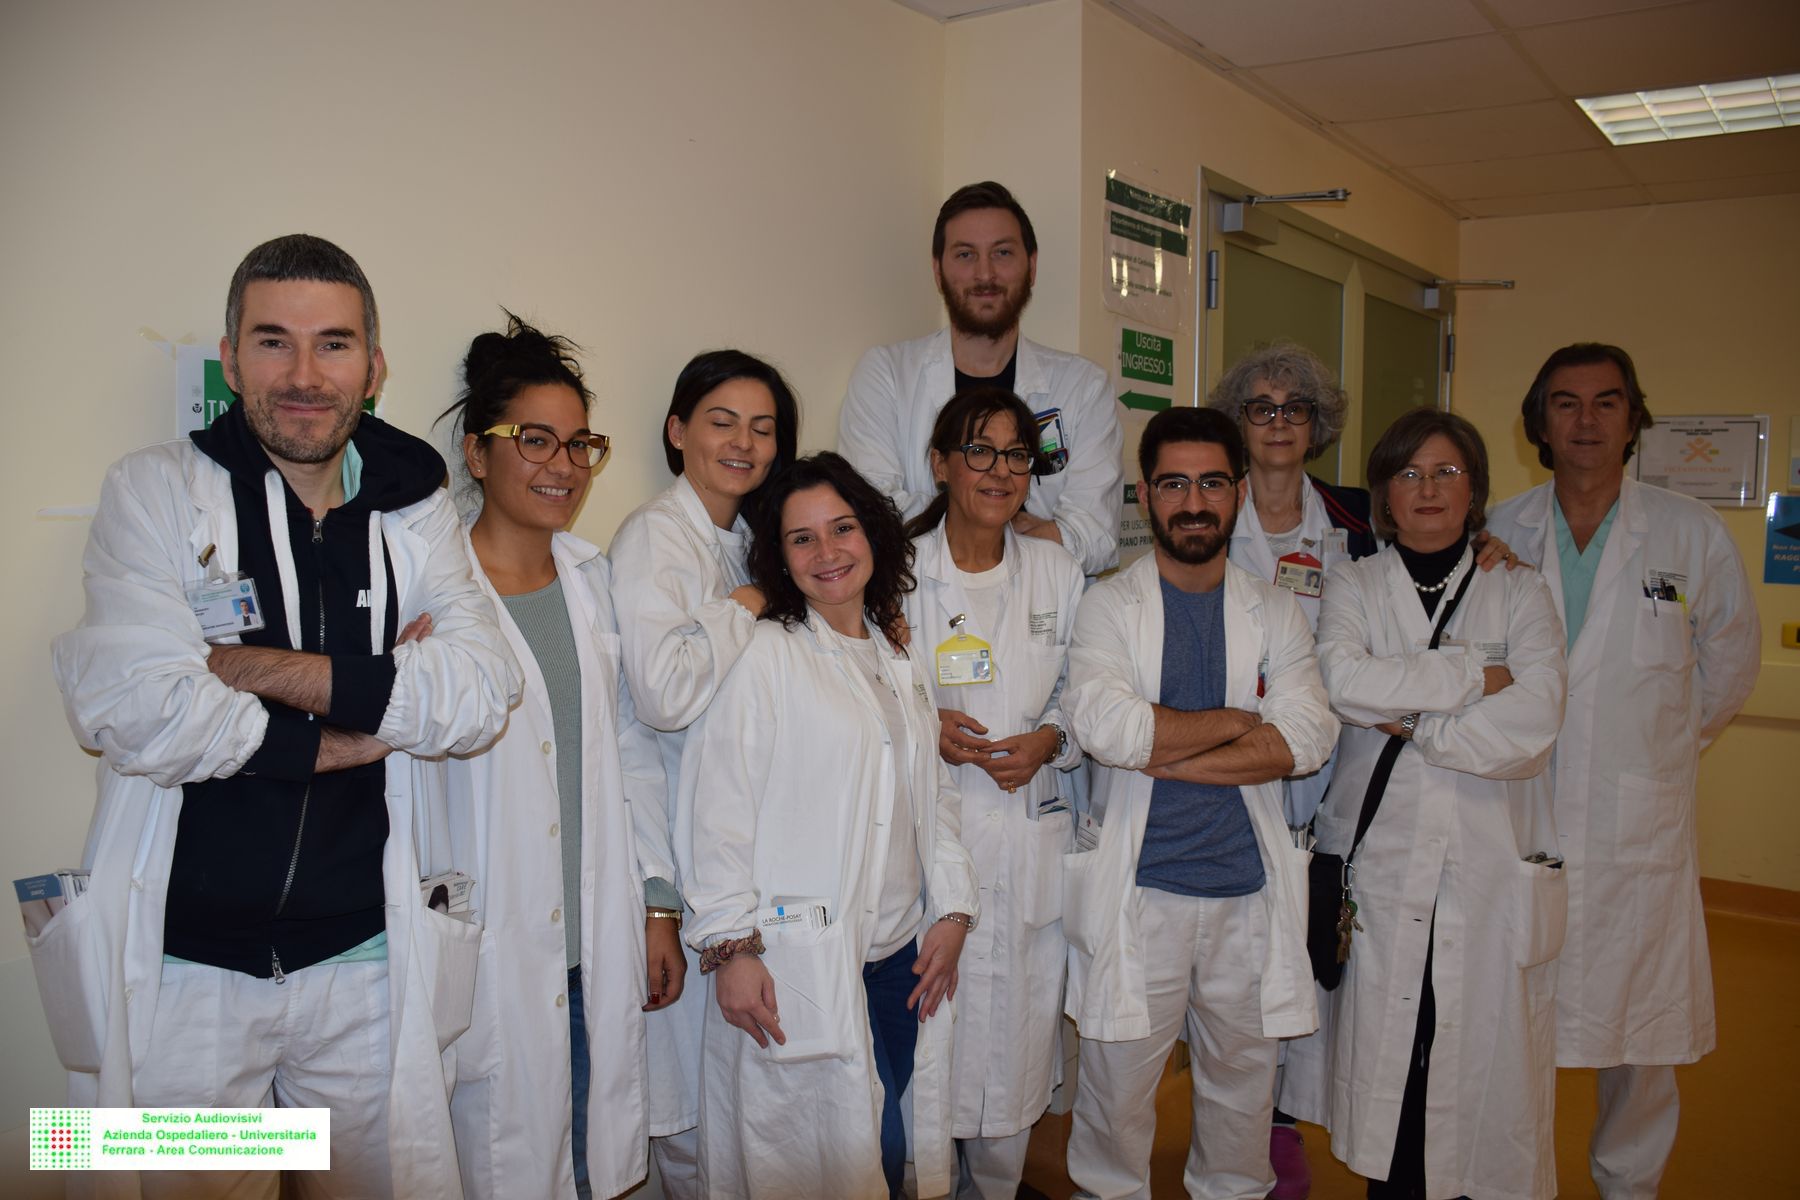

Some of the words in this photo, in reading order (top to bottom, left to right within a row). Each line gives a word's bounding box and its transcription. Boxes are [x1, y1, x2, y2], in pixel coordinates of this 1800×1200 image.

[1136, 331, 1161, 352] Uscita
[1122, 352, 1166, 375] INGRESSO
[1168, 362, 1173, 376] 1
